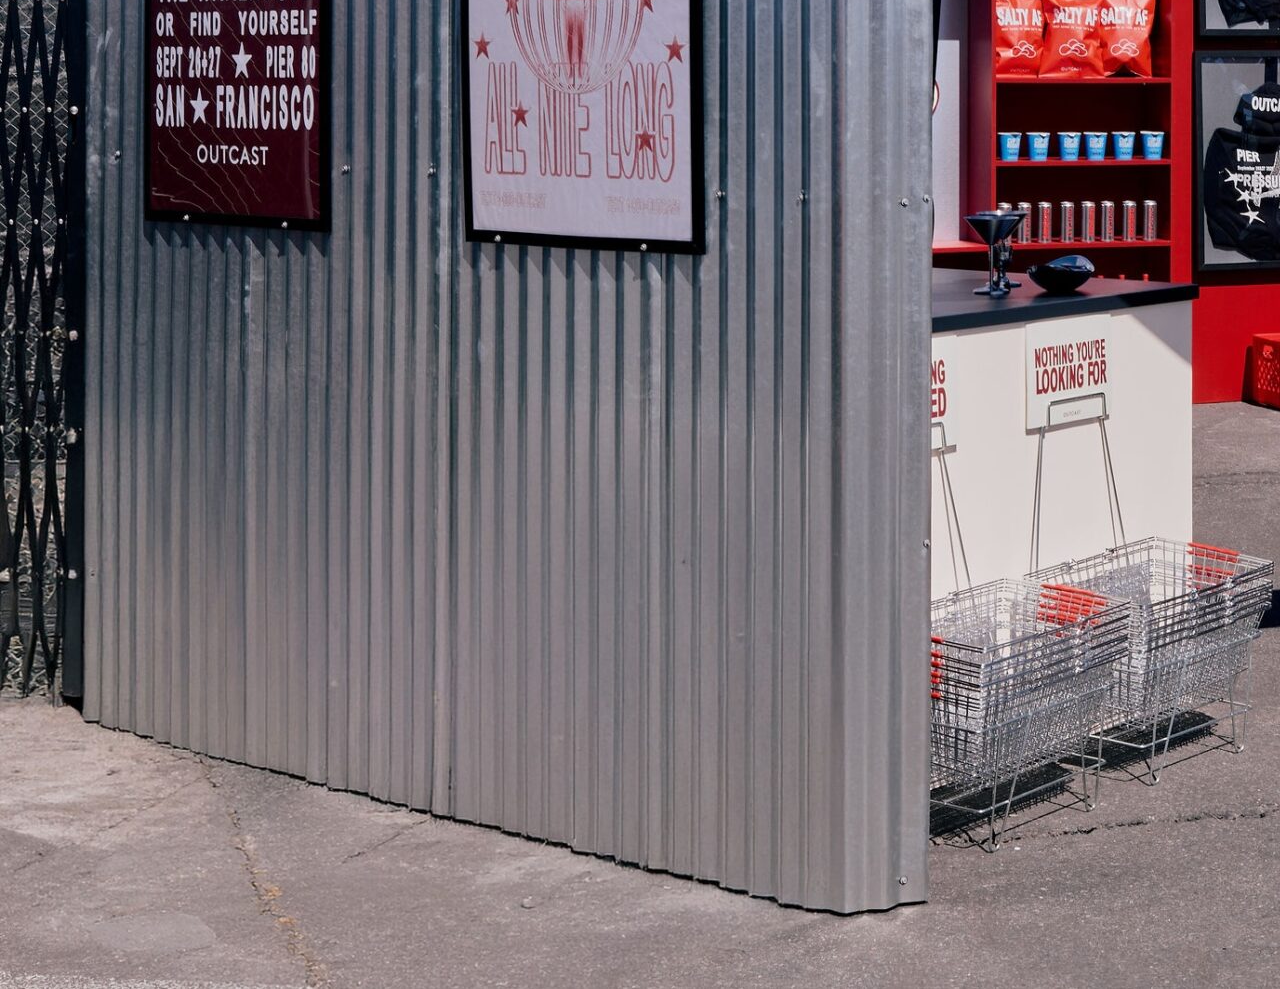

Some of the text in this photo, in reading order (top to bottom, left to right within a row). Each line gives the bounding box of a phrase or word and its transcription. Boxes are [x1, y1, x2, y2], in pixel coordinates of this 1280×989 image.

[155, 9, 318, 37] OR FIND YOURSELF
[996, 7, 1029, 27] SALTY
[1053, 7, 1099, 27] SALTY AF
[1101, 7, 1148, 27] SALTY AF
[156, 45, 183, 78] SEPT
[266, 45, 295, 78] PIER
[302, 45, 316, 79] 80
[155, 83, 315, 130] SAN FRANCISCO
[484, 61, 527, 175] ALL
[605, 60, 675, 182] LONG
[196, 144, 269, 166] OUTCAST
[1236, 149, 1260, 163] PIER
[1034, 338, 1106, 369] NOTHING YOU'RE
[1035, 359, 1107, 395] LOOKING FOR
